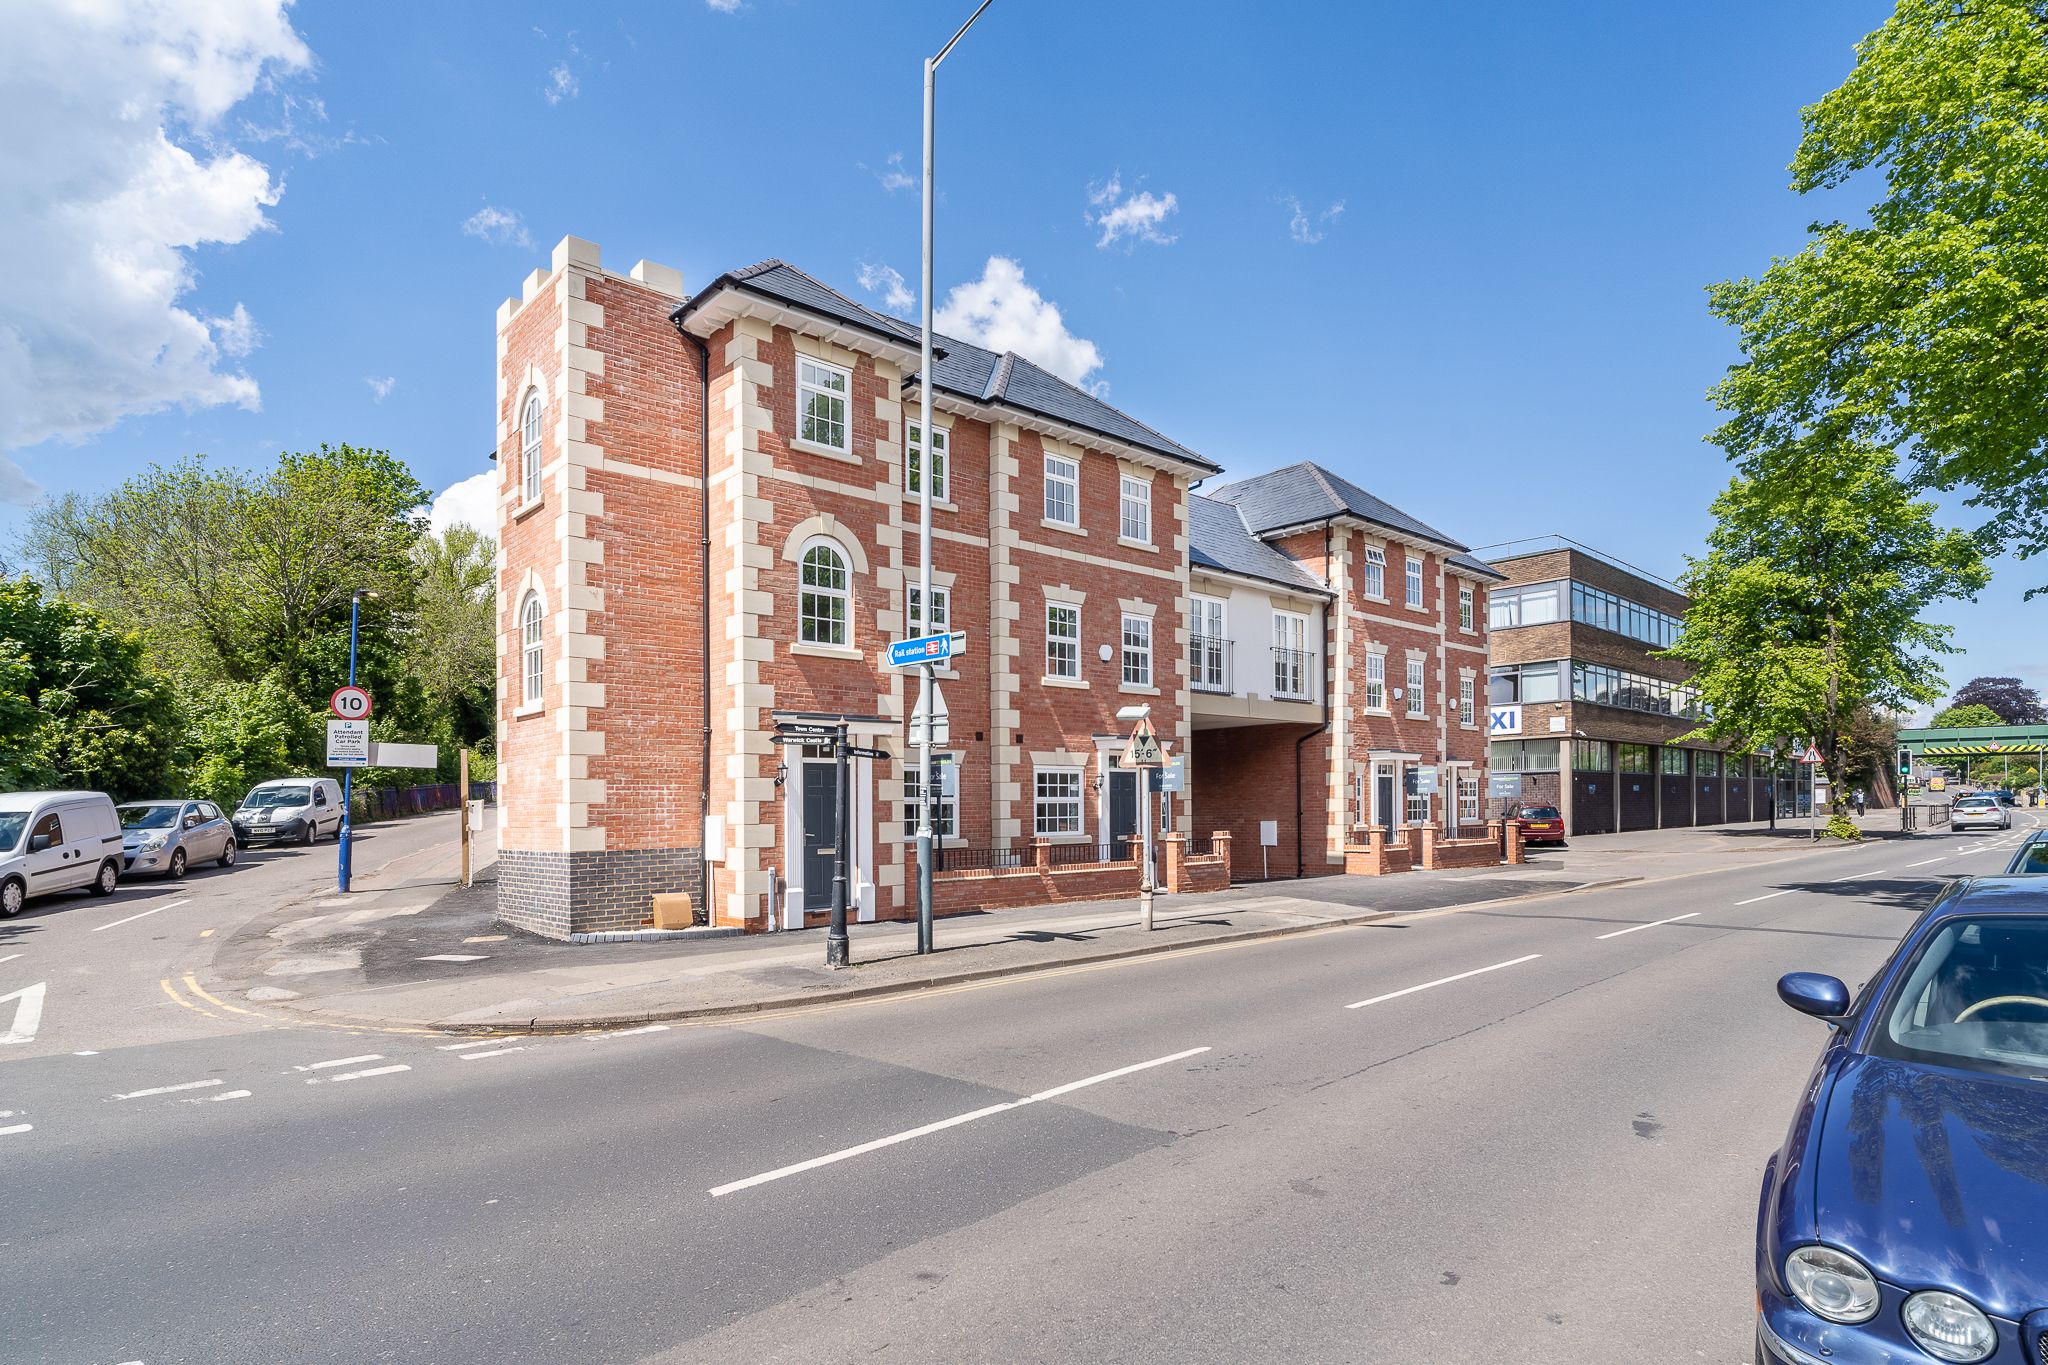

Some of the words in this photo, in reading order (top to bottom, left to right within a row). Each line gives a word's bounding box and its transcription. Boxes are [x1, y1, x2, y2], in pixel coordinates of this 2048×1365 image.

[894, 649, 905, 658] Rail
[905, 646, 925, 656] station
[341, 697, 362, 710] 10
